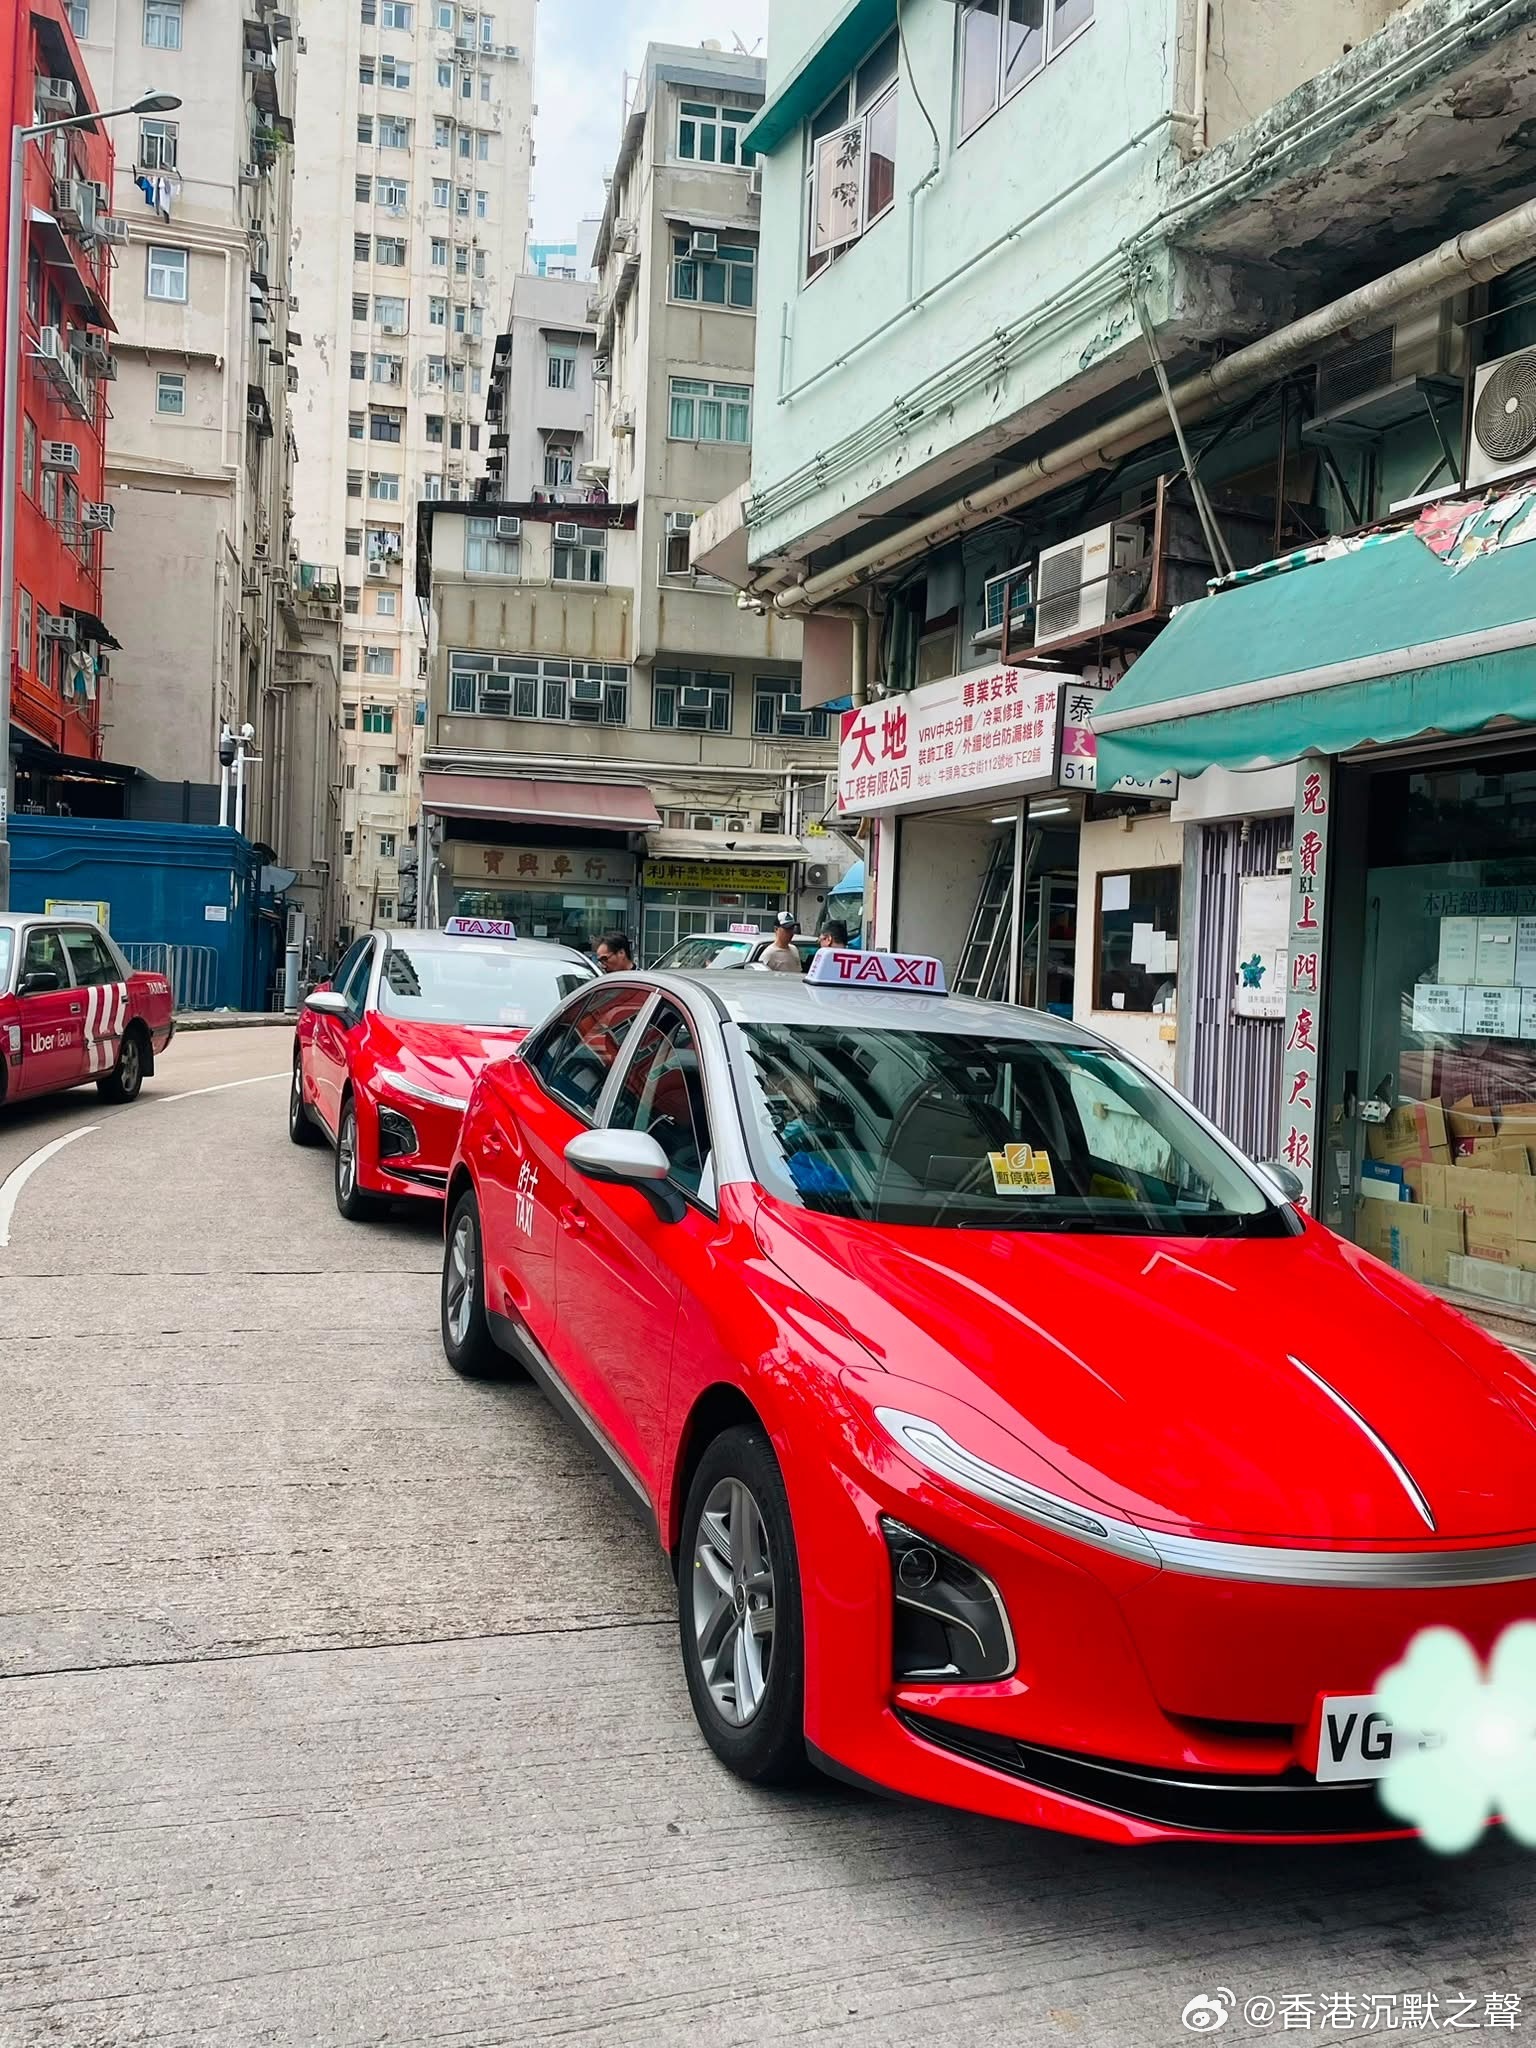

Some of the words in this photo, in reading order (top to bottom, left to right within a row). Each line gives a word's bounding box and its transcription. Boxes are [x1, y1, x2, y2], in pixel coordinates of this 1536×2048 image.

[963, 669, 1018, 707] 專業安裝
[851, 705, 908, 770] 大地
[845, 764, 912, 801] 工程有限公司
[456, 919, 510, 935] TAXI
[833, 952, 937, 986] TAXI
[31, 1032, 55, 1053] Uber
[56, 1028, 72, 1047] Taxi
[517, 1160, 539, 1200] 的士
[515, 1192, 534, 1238] TAXI
[1326, 1712, 1393, 1763] VG
